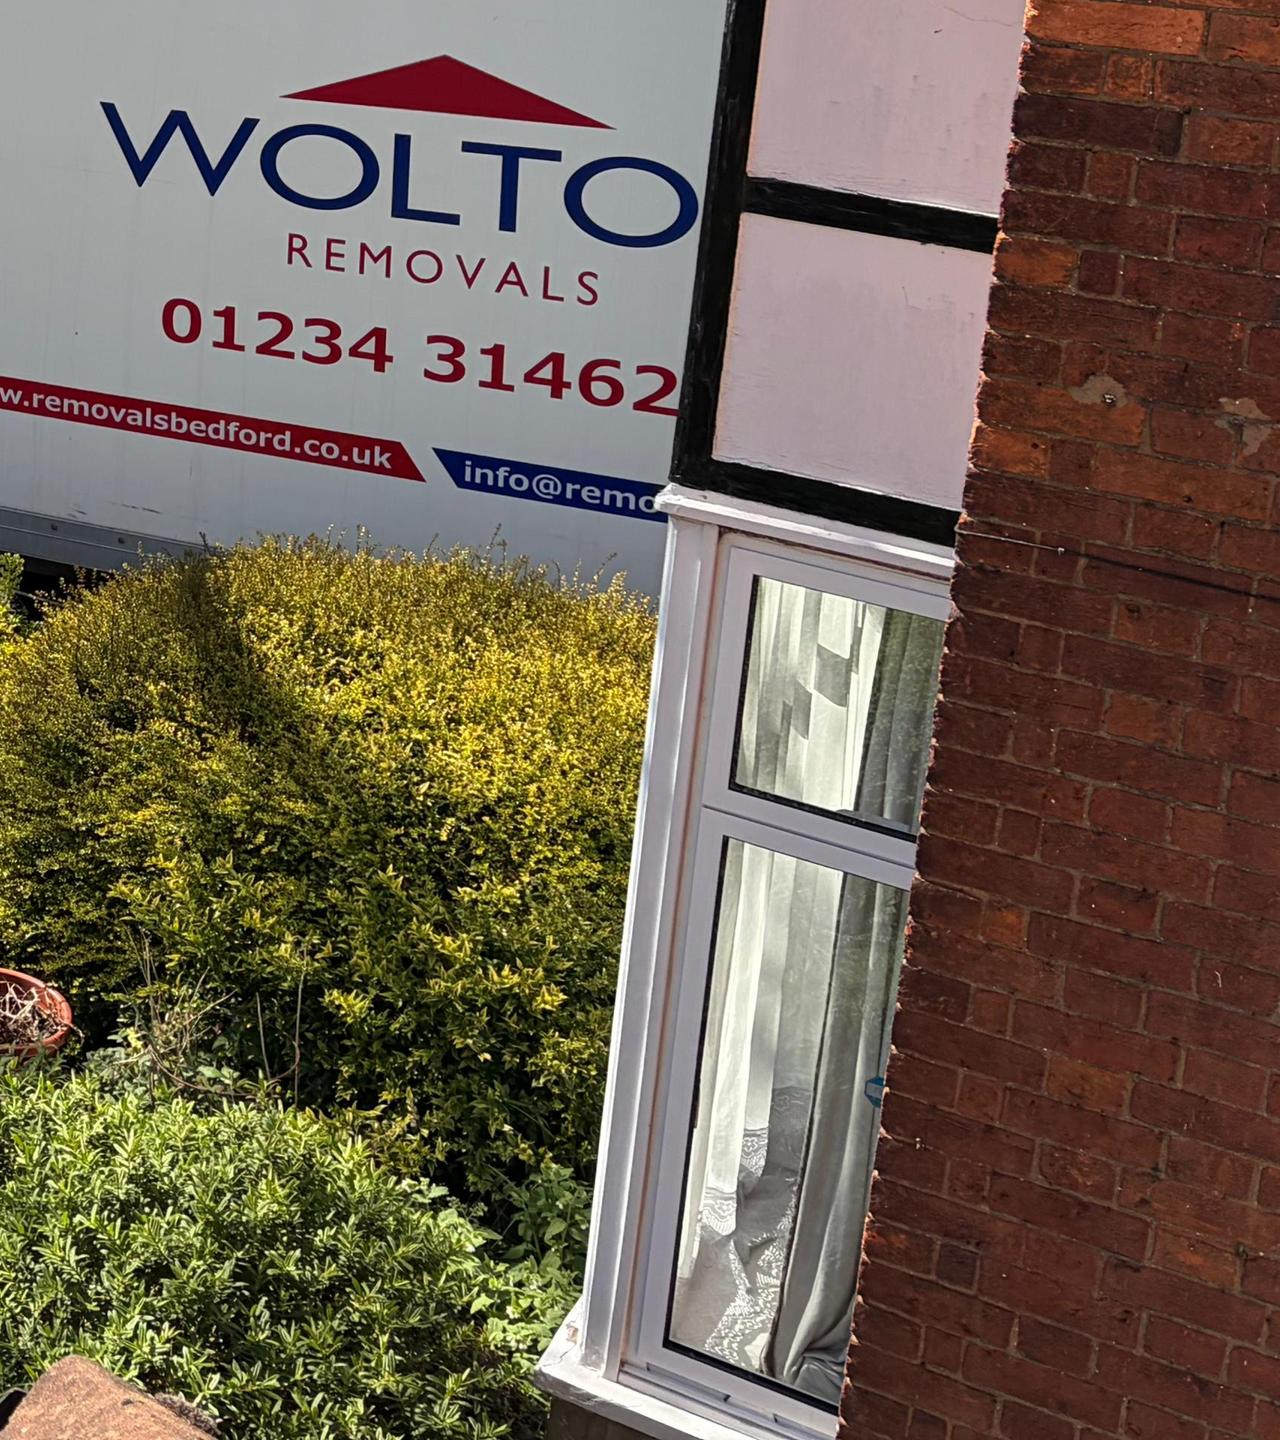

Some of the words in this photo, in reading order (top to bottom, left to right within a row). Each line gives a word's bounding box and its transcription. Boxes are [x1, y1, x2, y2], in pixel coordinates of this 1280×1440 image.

[100, 101, 699, 248] WOLTO
[286, 232, 599, 306] REMOVALS
[161, 298, 394, 373] 01234
[423, 334, 680, 417] 31462
[463, 460, 657, 513] info@remo
